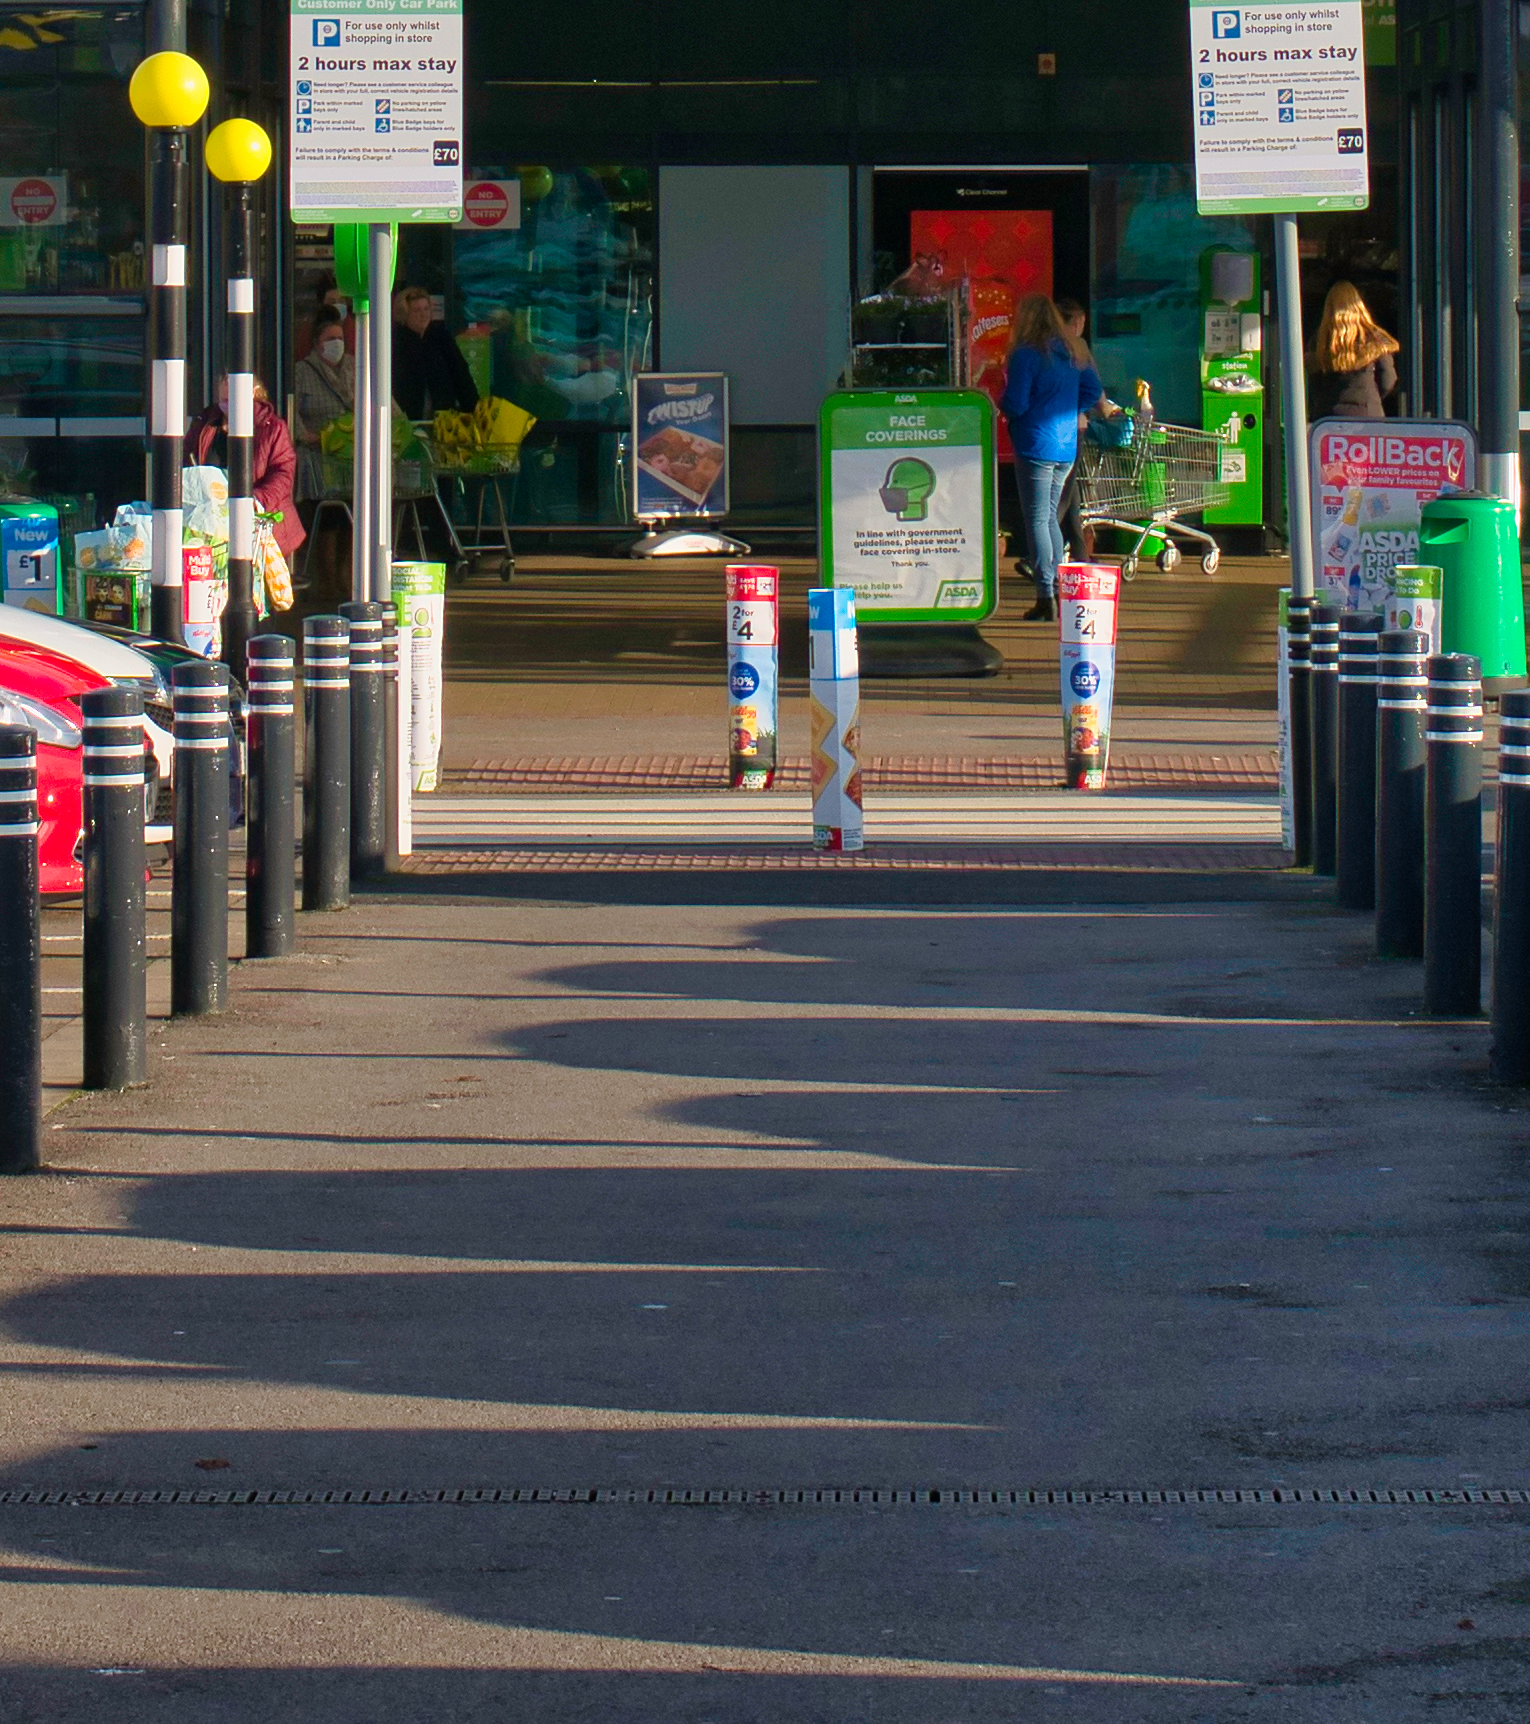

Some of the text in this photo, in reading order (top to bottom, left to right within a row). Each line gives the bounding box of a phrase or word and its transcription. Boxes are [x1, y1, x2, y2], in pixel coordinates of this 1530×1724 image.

[1245, 9, 1340, 21] For use only whilst
[345, 21, 361, 30] For
[385, 21, 407, 32] only
[410, 21, 440, 30] whilst
[1245, 23, 1333, 35] shopping in store
[345, 33, 433, 45] shopping in store
[1199, 45, 1358, 63] 2 hours max stay
[298, 56, 457, 74] 2 hours max stay
[1339, 135, 1363, 148] £70
[324, 147, 347, 155] comply
[434, 148, 458, 161] £70
[337, 154, 361, 162] Parking
[362, 154, 384, 162] Charge
[25, 188, 41, 196] NO
[478, 191, 493, 199] NO
[18, 207, 49, 215] ENTRY
[470, 210, 501, 218] ENTRY
[1222, 362, 1248, 370] station
[894, 394, 917, 403] ASDA
[890, 415, 926, 427] FACE
[866, 429, 947, 442] COVERINGS
[1329, 436, 1459, 467] RollBack
[1369, 467, 1400, 476] LOWER
[1402, 468, 1427, 477] prices
[1369, 476, 1438, 486] family favourites
[14, 529, 48, 541] New
[867, 530, 884, 538] line
[886, 529, 905, 537] with
[908, 528, 963, 539] government
[853, 539, 903, 549] guidelines,
[905, 538, 934, 547] please
[1359, 532, 1419, 553] ASDA
[860, 547, 960, 557] face covering in-store.
[189, 555, 211, 566] Multi
[891, 560, 913, 568] Thank
[1366, 553, 1415, 566] PRICE
[191, 566, 209, 576] Buy
[871, 582, 891, 592] help
[944, 587, 978, 598] ASDA
[1061, 584, 1079, 595] Buy
[732, 606, 741, 619] 2
[1076, 605, 1086, 618] 2
[732, 620, 754, 640] £4
[1075, 619, 1096, 639] £4
[732, 676, 755, 687] 30%
[1075, 675, 1097, 685] 30%
